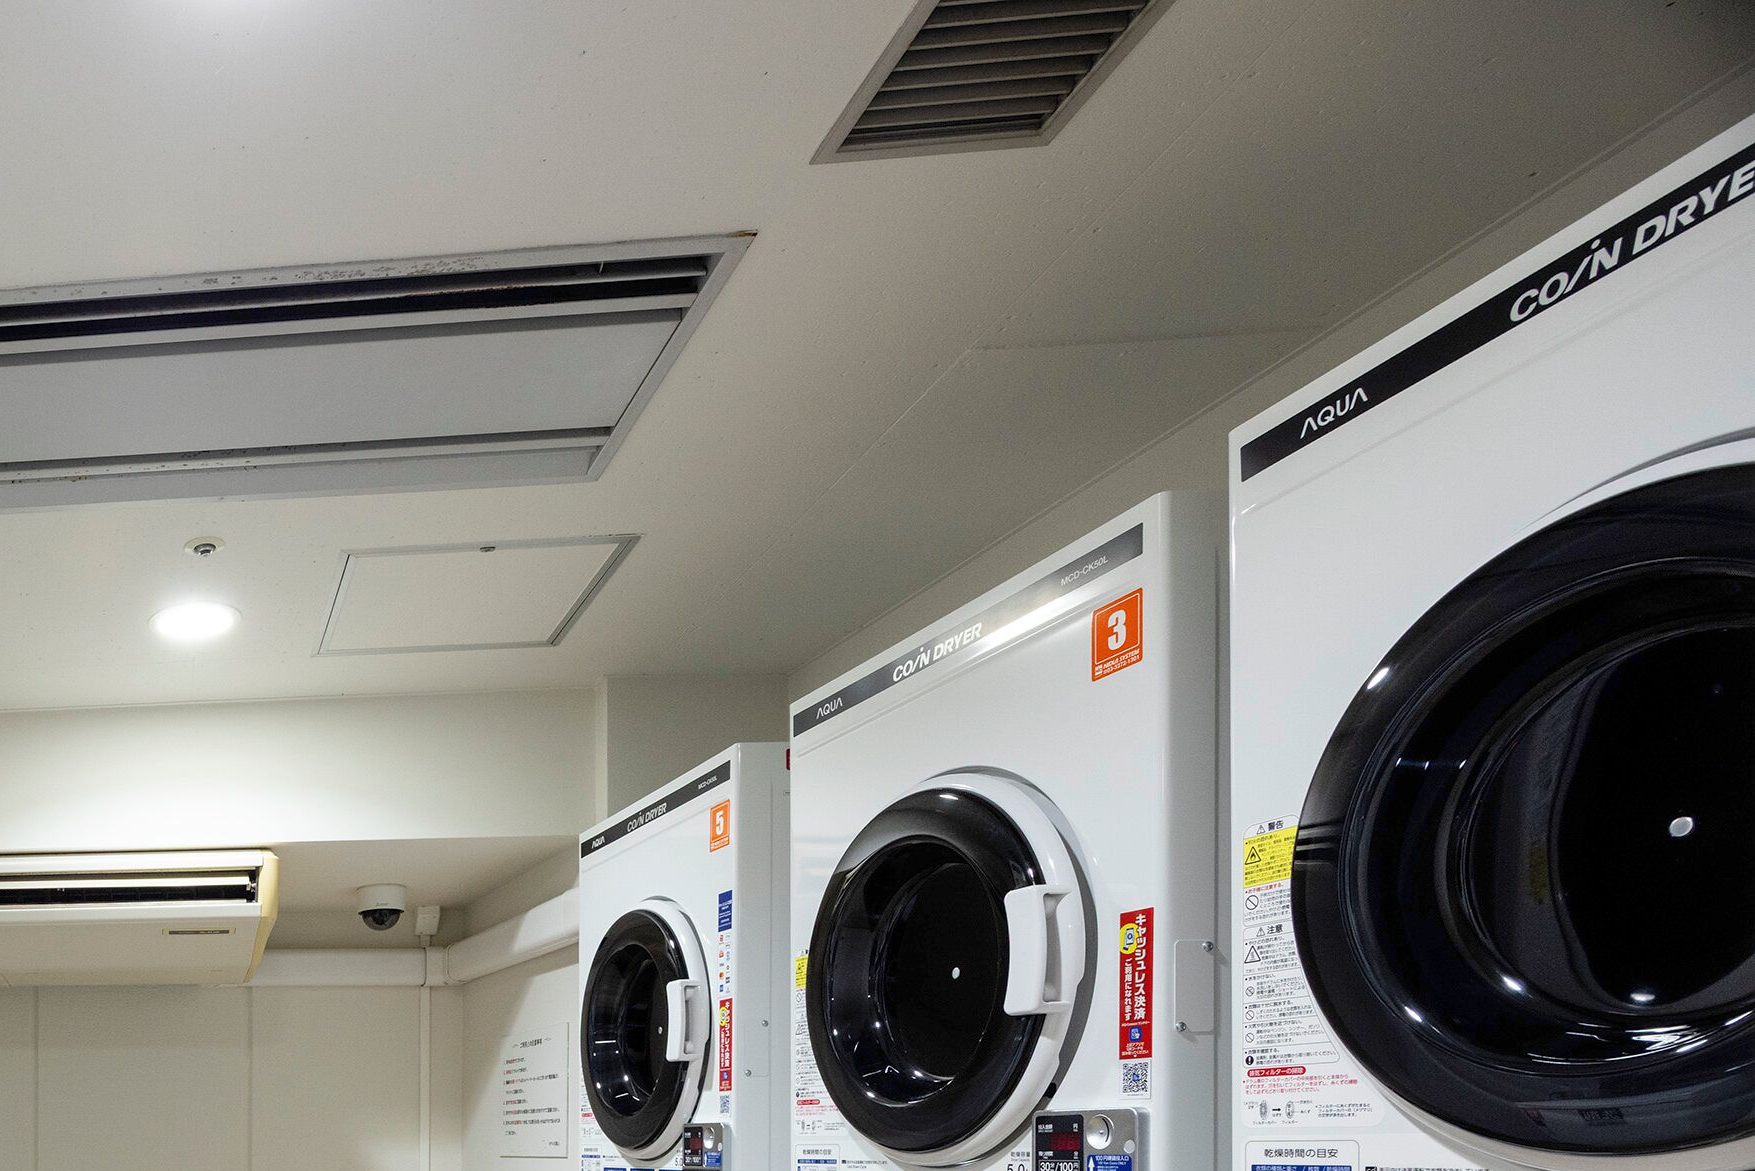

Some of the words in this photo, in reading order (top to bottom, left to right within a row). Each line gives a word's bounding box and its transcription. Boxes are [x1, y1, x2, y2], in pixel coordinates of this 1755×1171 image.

[1631, 160, 1755, 256] DRYE
[1300, 388, 1368, 439] AQUA
[1060, 555, 1108, 586] MCD-CK50L
[933, 622, 983, 661] DRYER
[1107, 609, 1127, 651] 3
[816, 697, 843, 719] AQUA
[644, 803, 667, 823] DRYER
[715, 810, 724, 835] 5
[1134, 913, 1147, 1021] キャッシュレス決済
[1264, 1148, 1338, 1159] 乾燥時間の目安
